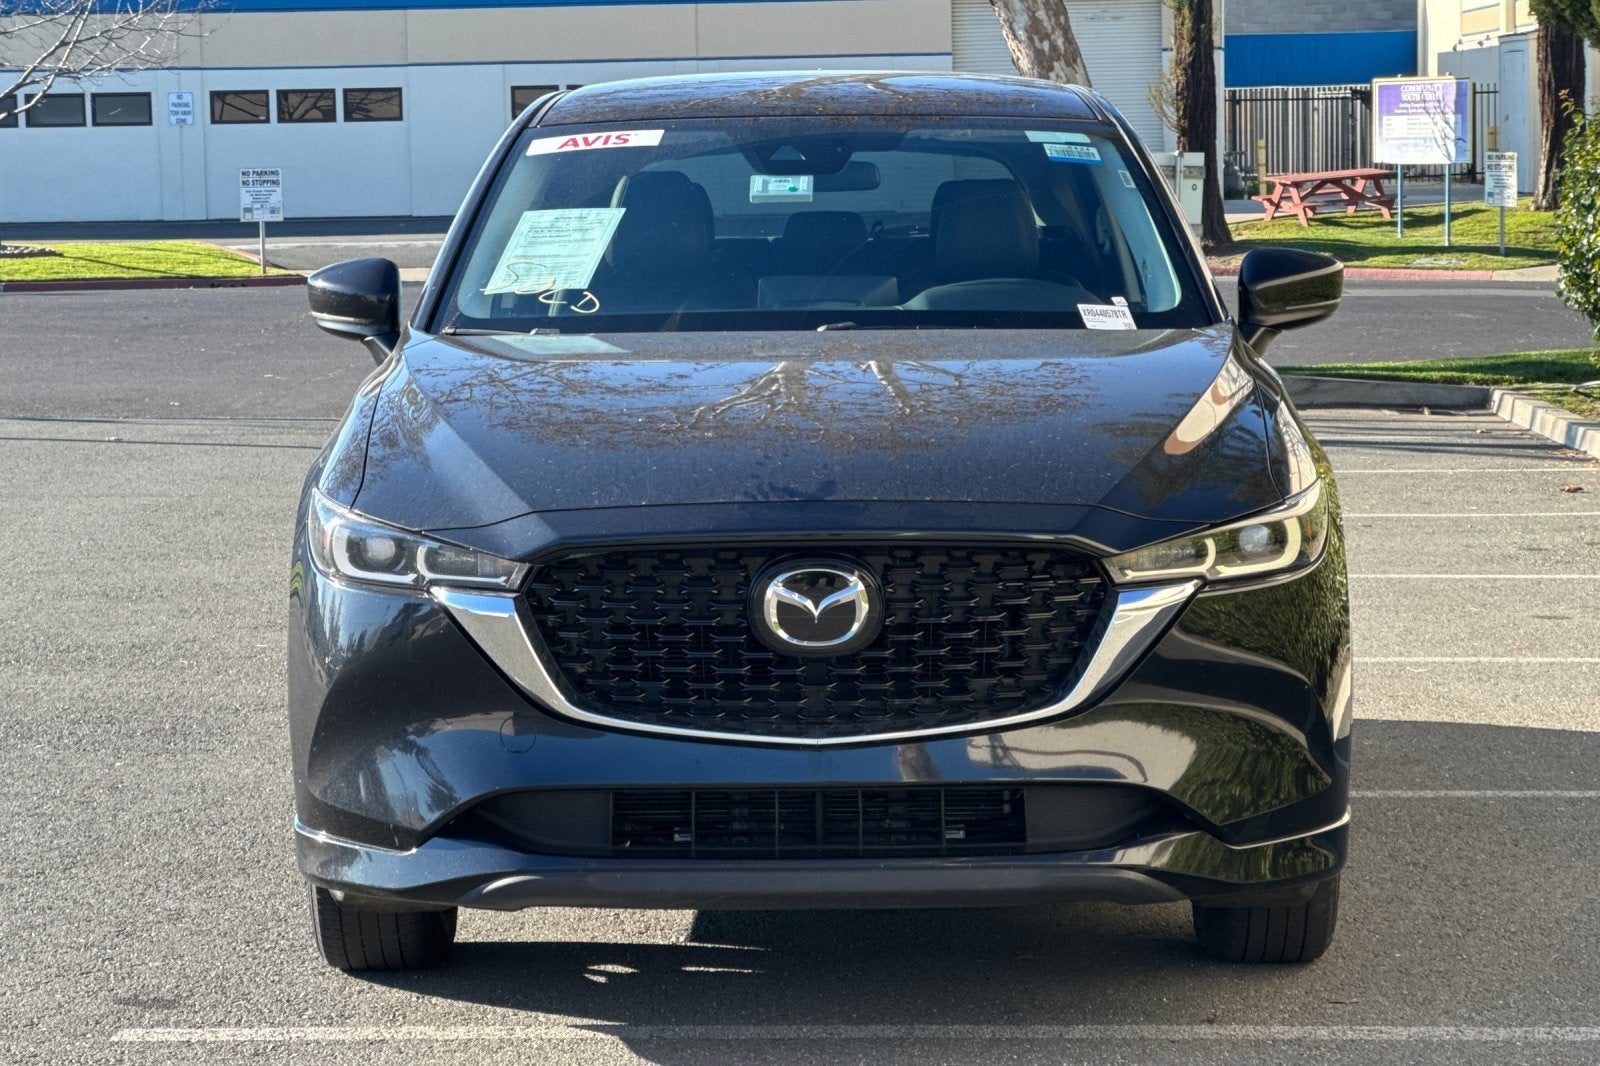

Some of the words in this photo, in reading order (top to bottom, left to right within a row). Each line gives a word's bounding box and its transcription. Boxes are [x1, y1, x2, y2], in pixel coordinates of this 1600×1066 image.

[1400, 84, 1444, 92] COMMUNITY
[557, 133, 631, 150] AVIS
[252, 169, 280, 177] PARKING
[251, 179, 280, 187] STOPPING
